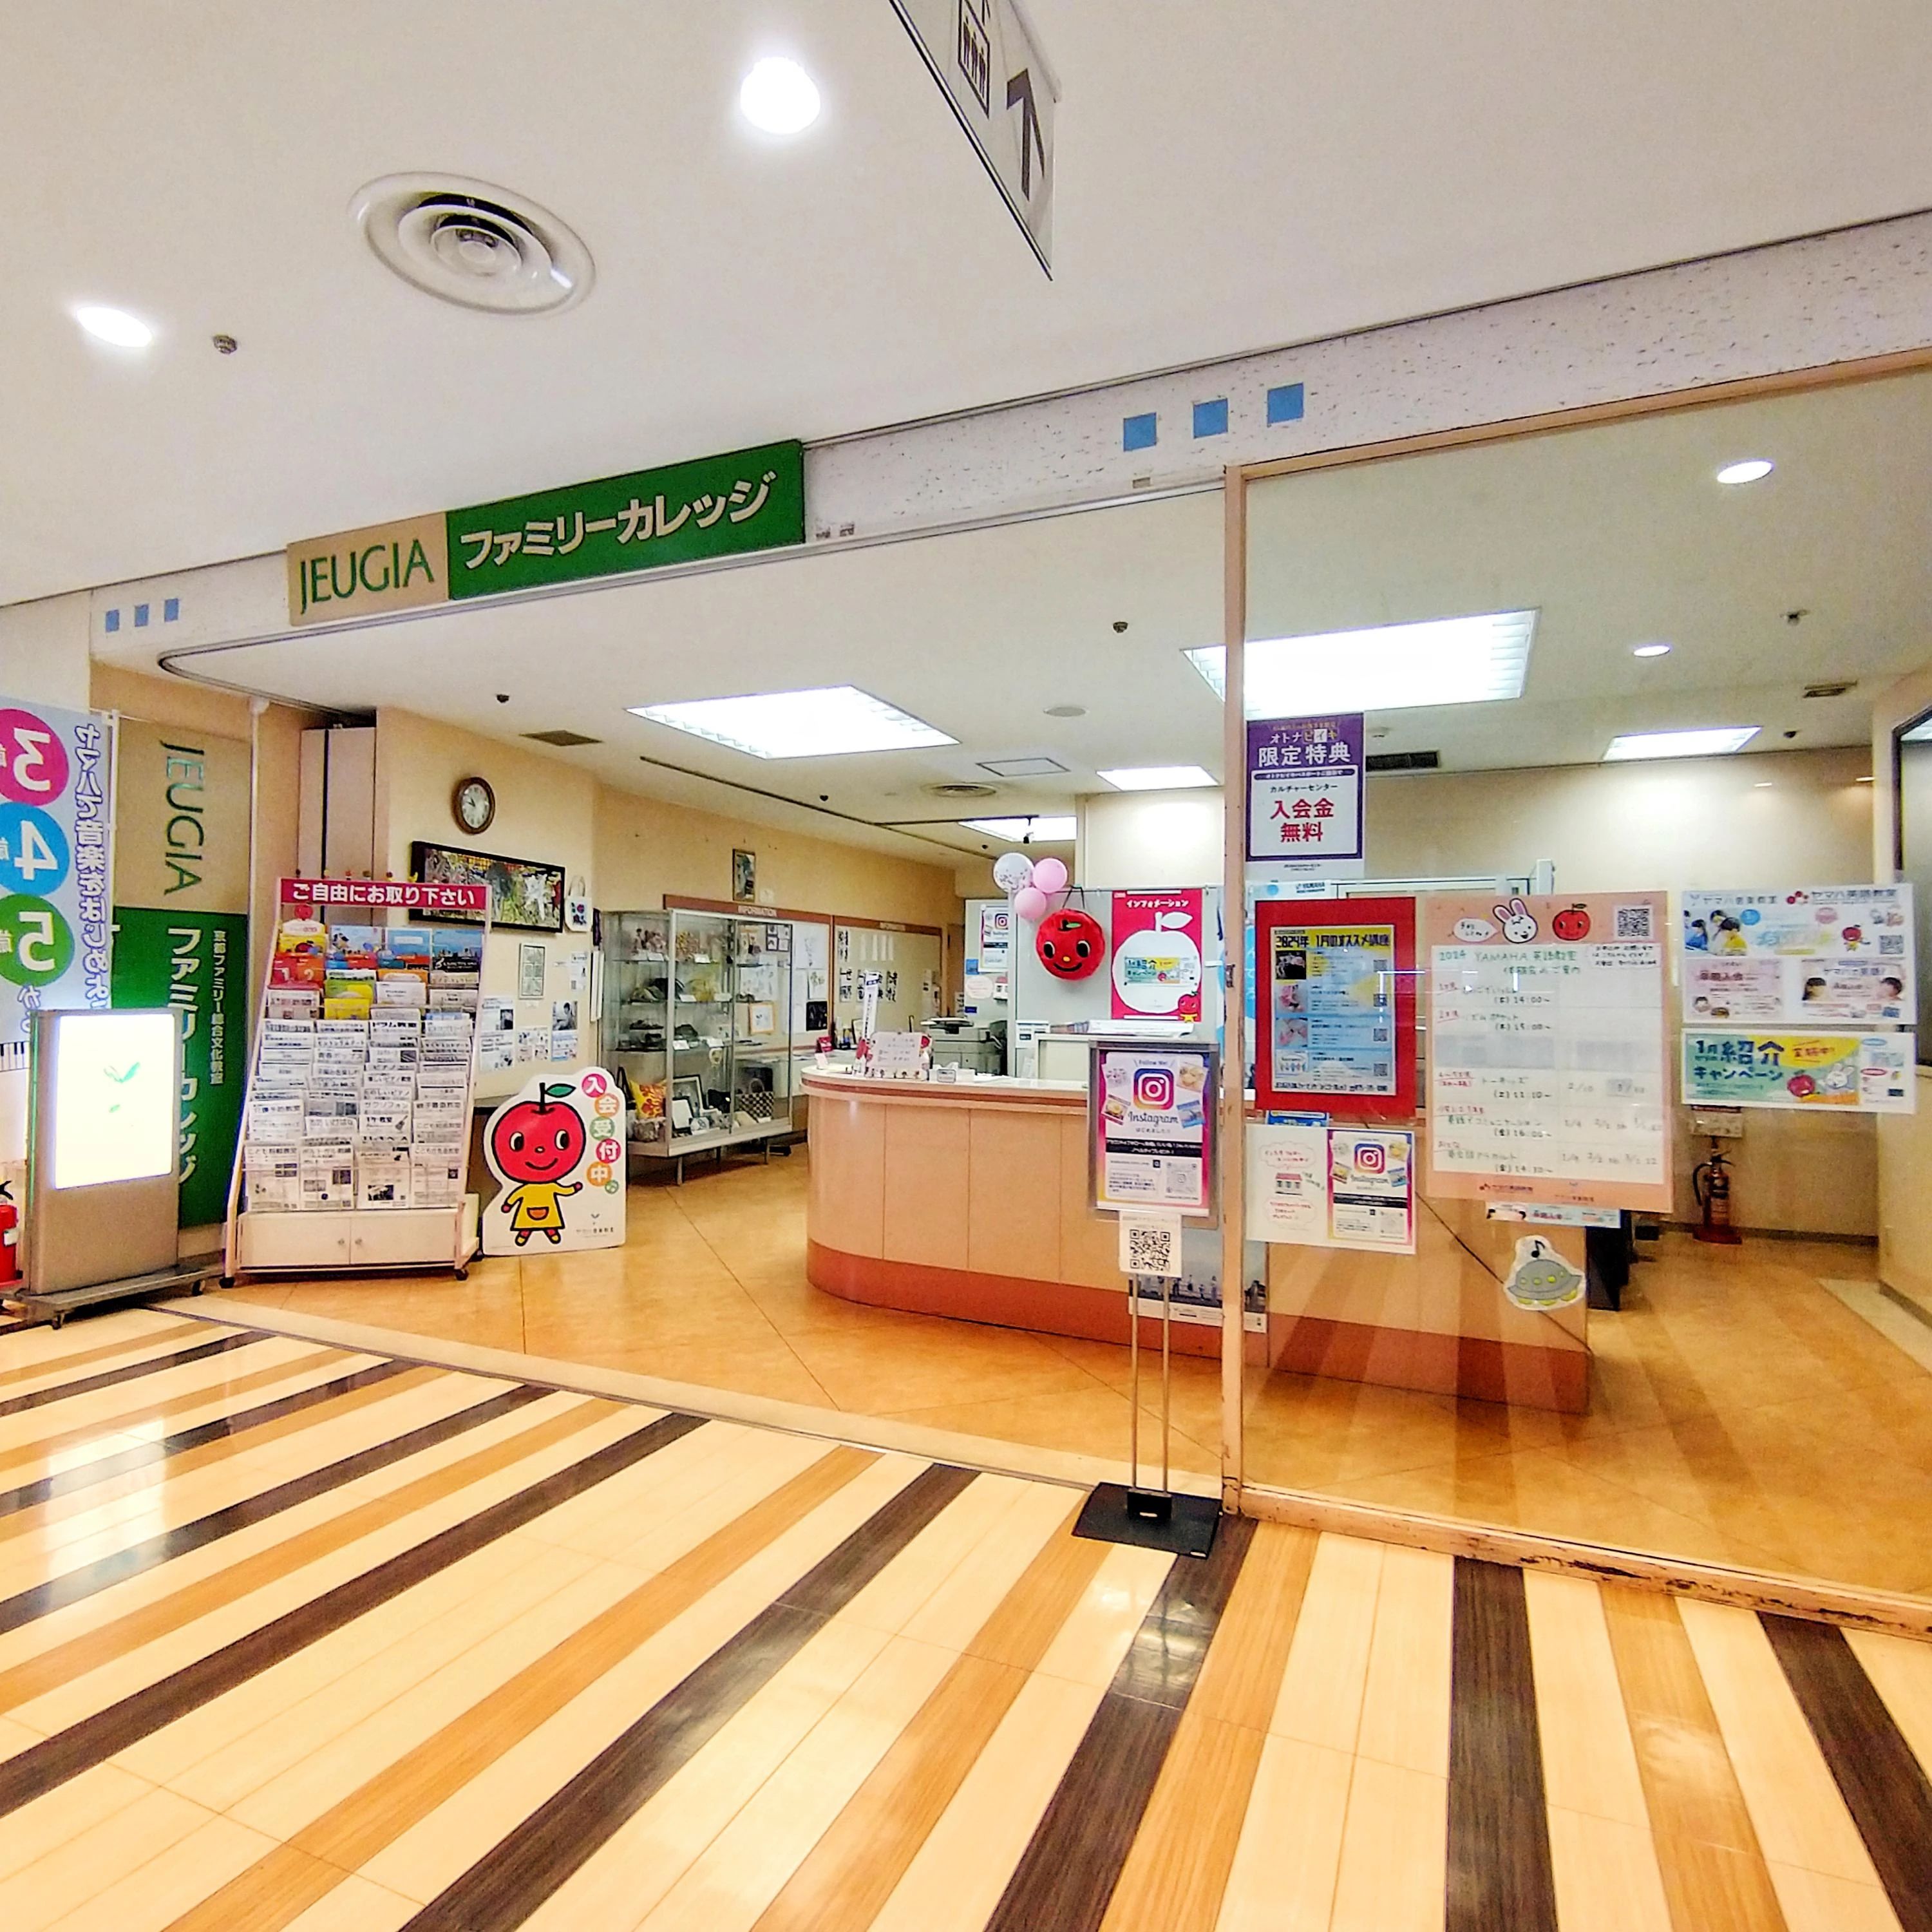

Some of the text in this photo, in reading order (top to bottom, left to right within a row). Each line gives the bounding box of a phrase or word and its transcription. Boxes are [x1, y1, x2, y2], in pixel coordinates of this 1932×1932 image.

[460, 471, 777, 569] ファミリーカレッジ
[299, 538, 435, 614] JEUGIA
[1258, 742, 1351, 767] 限定特典
[1270, 783, 1338, 793] カルチャーセンター
[159, 739, 205, 896] JEUGIA
[1270, 798, 1334, 819] 入会金
[1280, 822, 1323, 842] 無料
[292, 882, 475, 905] ご自由にお取り下さい
[1694, 1066, 1784, 1081] キャンペーン
[1128, 1111, 1179, 1127] Instagram
